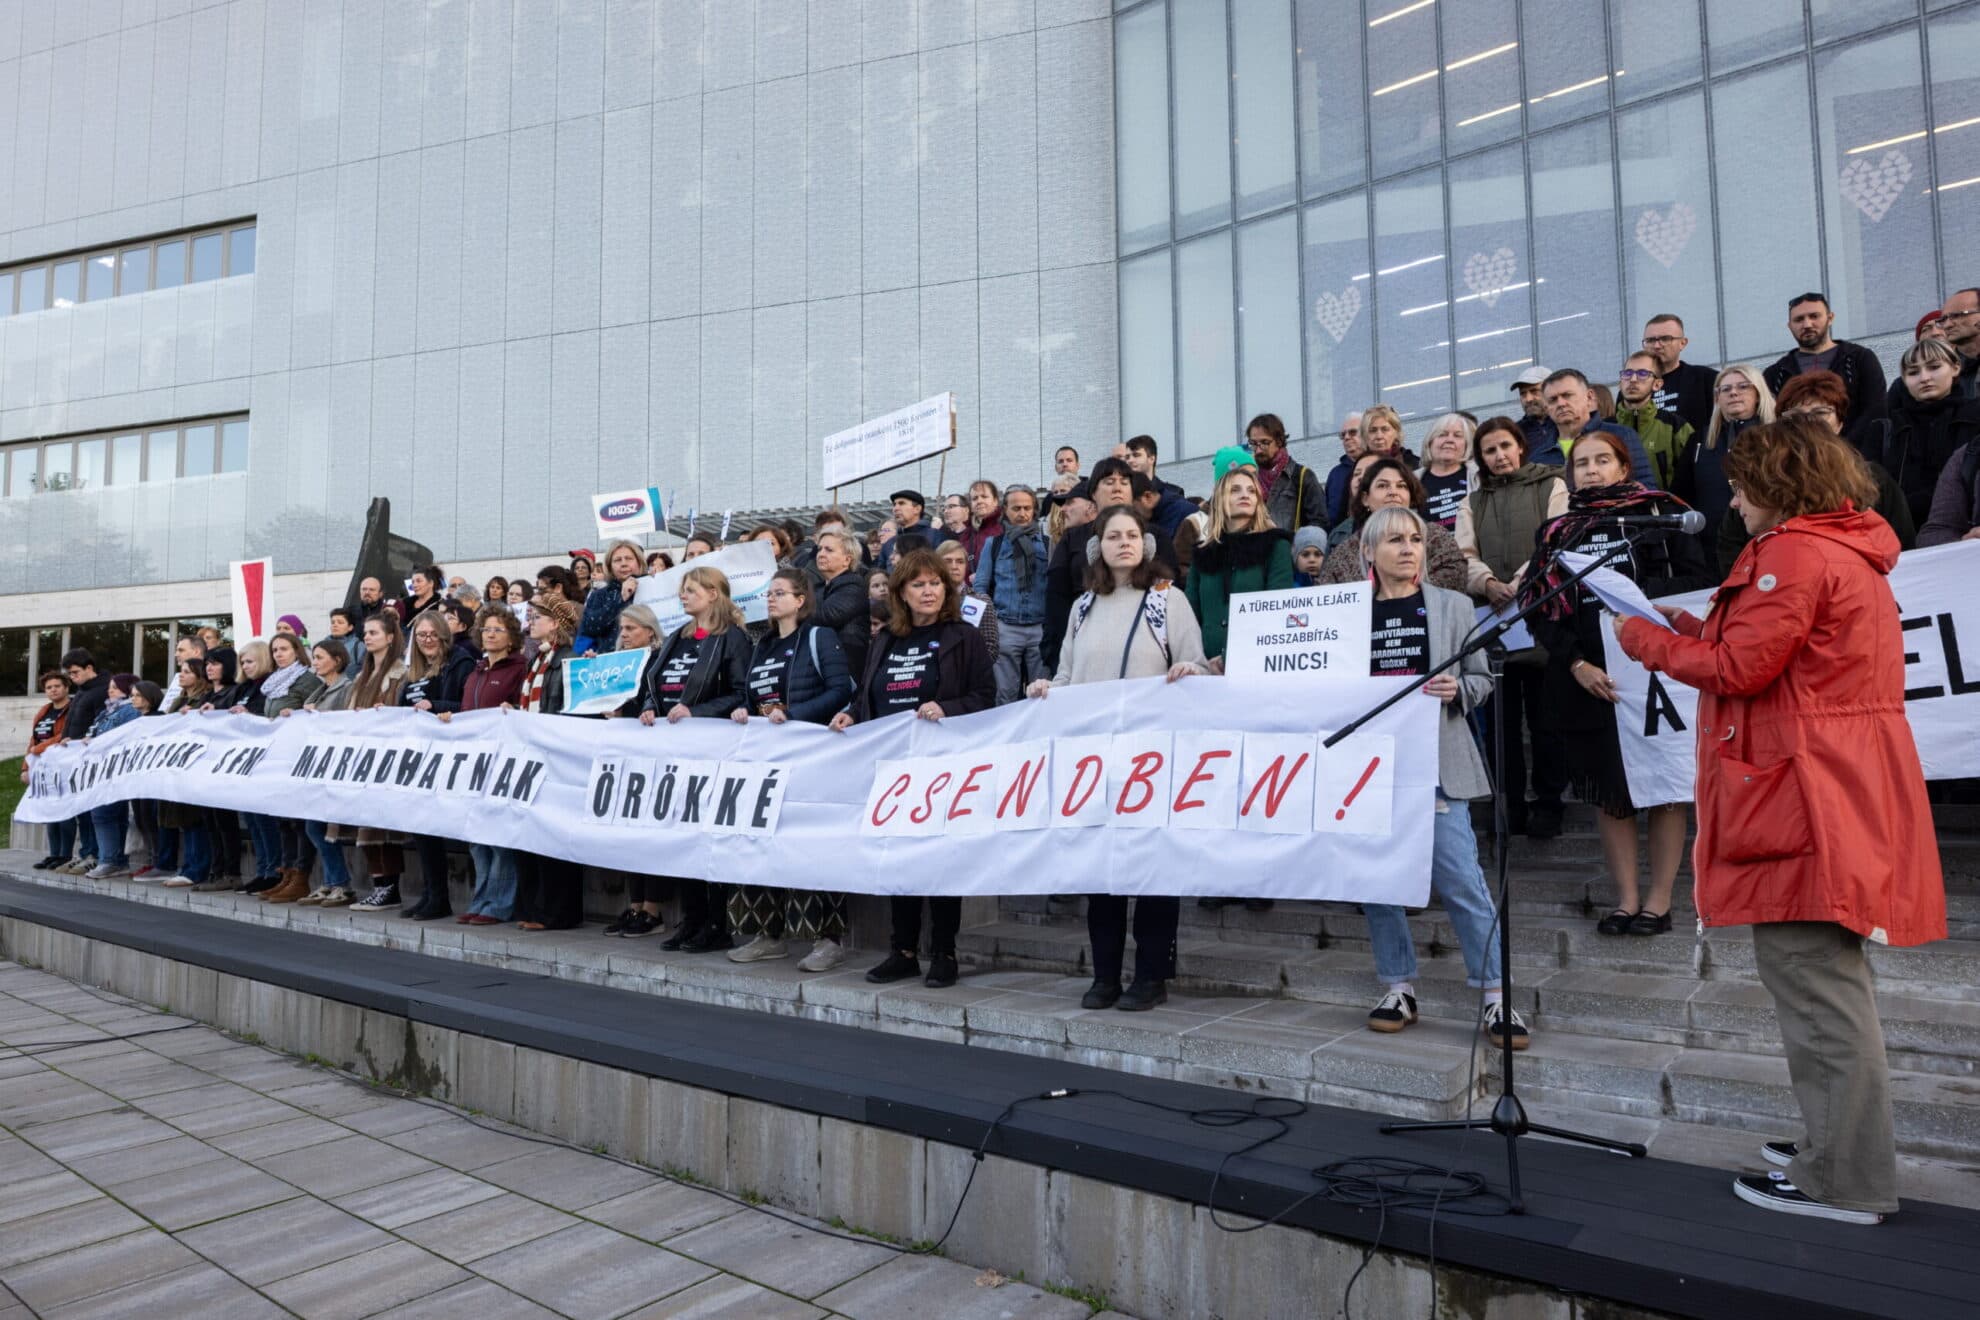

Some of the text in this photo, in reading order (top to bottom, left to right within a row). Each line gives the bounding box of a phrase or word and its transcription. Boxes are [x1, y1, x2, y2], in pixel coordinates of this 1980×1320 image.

[1239, 591, 1360, 614] A TÜRELMÜNK LEJÁRT.
[1256, 629, 1338, 647] HOSSZABBÍTÁS
[1264, 651, 1328, 673] NINCS!
[291, 744, 544, 802] MARADHATNAK
[592, 763, 778, 828] ÖRÖKKÉ
